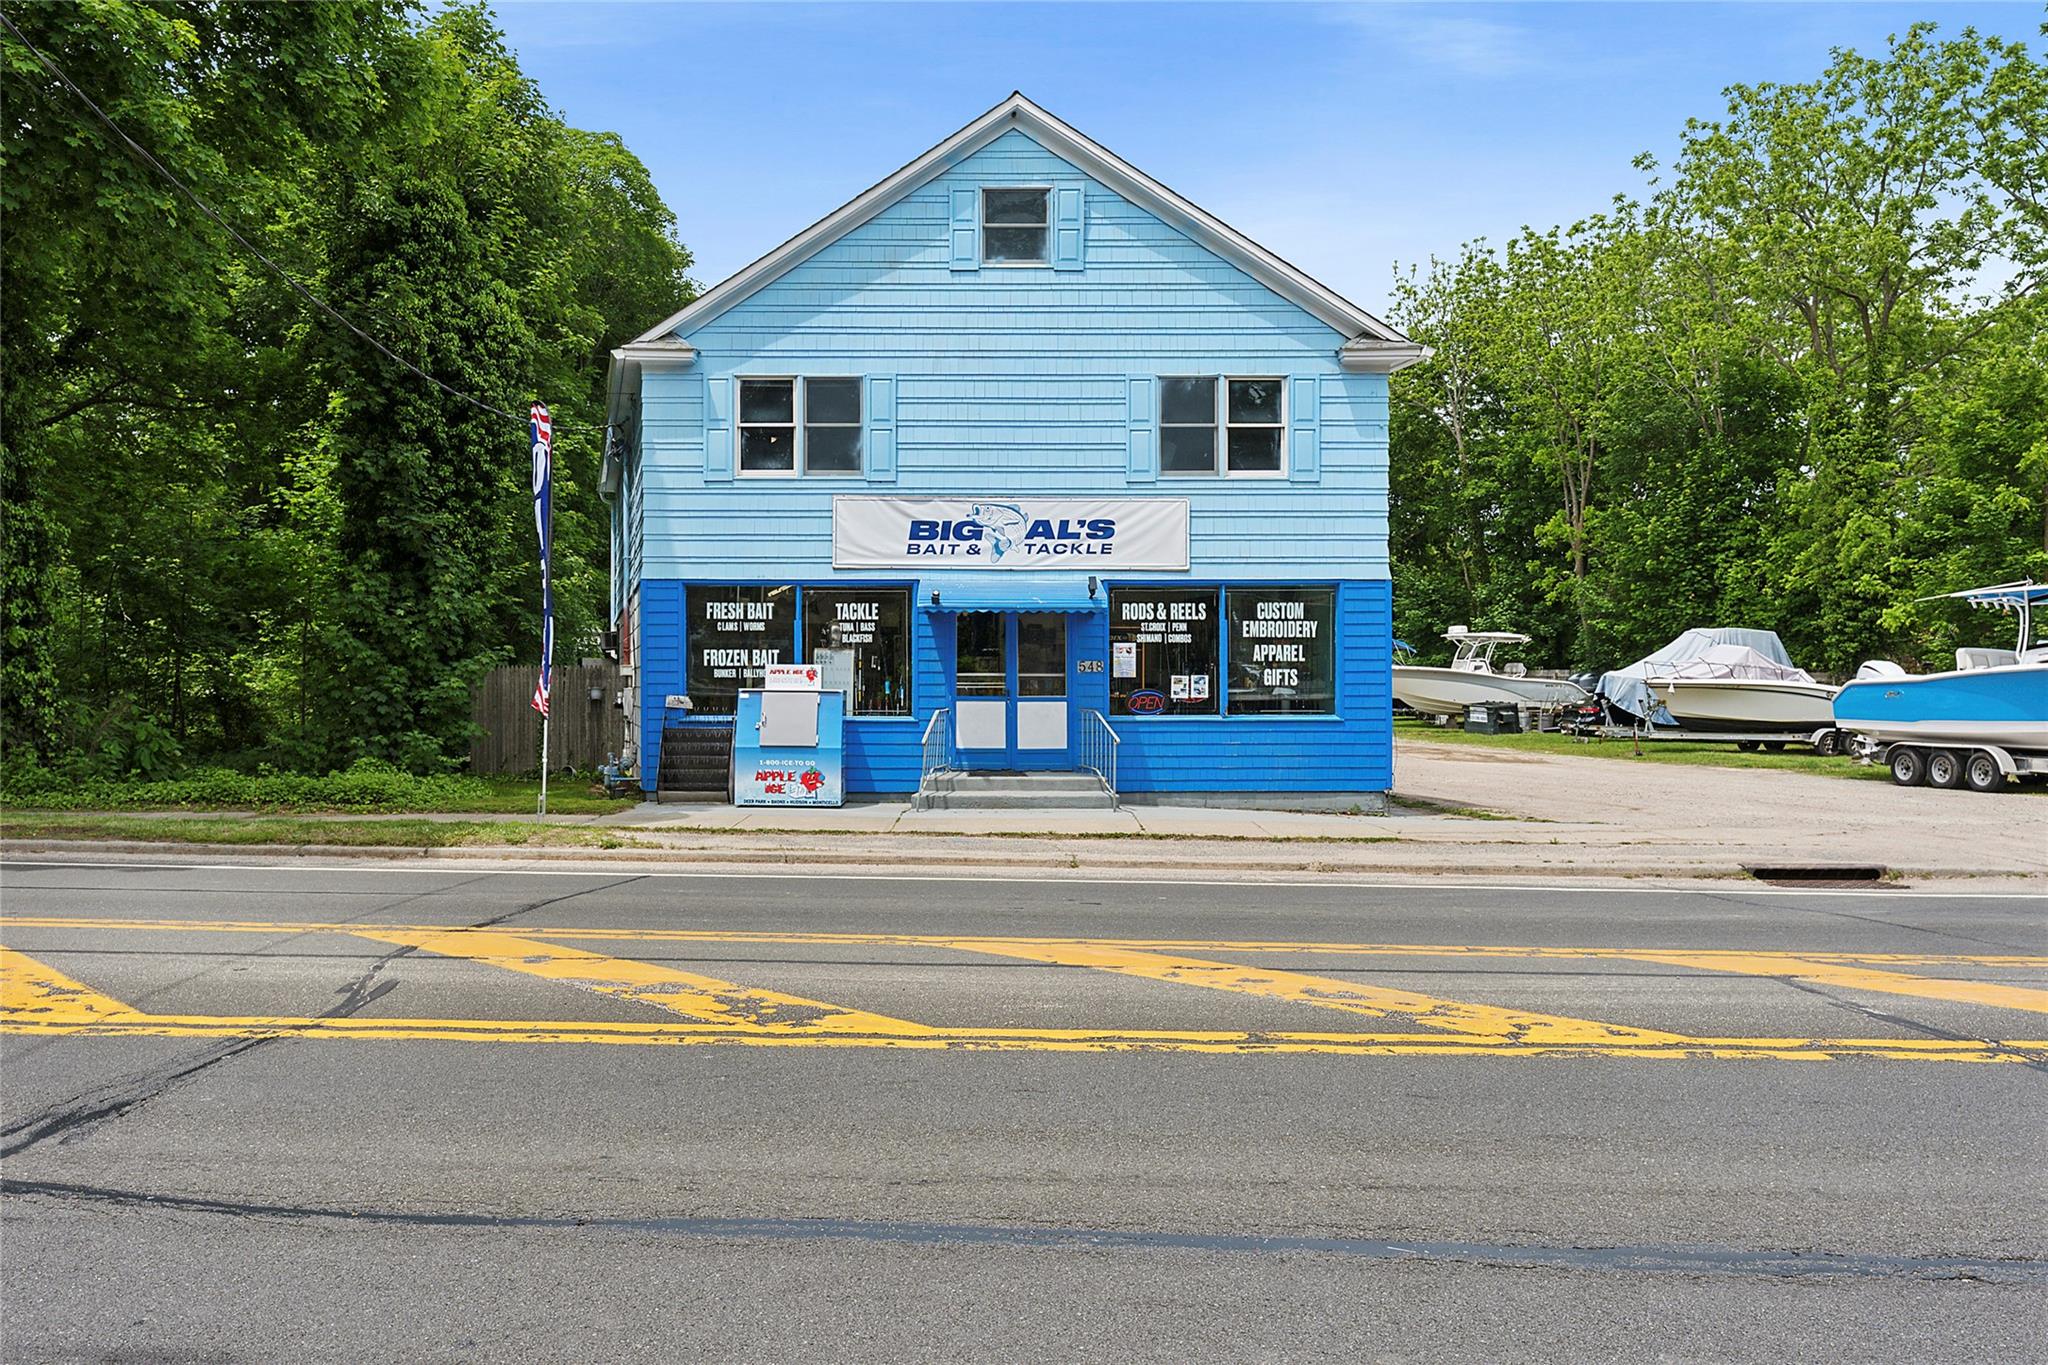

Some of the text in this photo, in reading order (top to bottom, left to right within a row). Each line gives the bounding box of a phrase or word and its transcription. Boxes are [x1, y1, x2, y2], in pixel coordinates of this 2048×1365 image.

[908, 519, 1116, 541] BIG AL'S
[906, 543, 1113, 555] BAIT & TACKLE
[706, 602, 774, 620] FRESH BAIT
[835, 603, 879, 620] TACKLE
[1122, 602, 1207, 620] RODS & REELS
[1257, 602, 1305, 620] CUSTOM
[717, 621, 766, 631] CLAMS WORMS
[839, 622, 876, 632] TUNA BASS
[1171, 622, 1188, 632] PENN
[1242, 620, 1318, 638] EMBROIDERY
[841, 633, 873, 643] BLACKFISH
[1136, 633, 1163, 643] SHIMANO
[1168, 633, 1192, 643] COMBOS
[703, 649, 779, 667] FROZEN BAIT
[1252, 644, 1306, 662] APPAREL
[713, 668, 766, 678] BUNKER BALLYHO
[1078, 661, 1104, 673] 548
[1263, 668, 1298, 686] GIFTS
[1128, 696, 1165, 710] OPEN
[755, 769, 797, 782] APPLE
[764, 783, 786, 794] ICE
